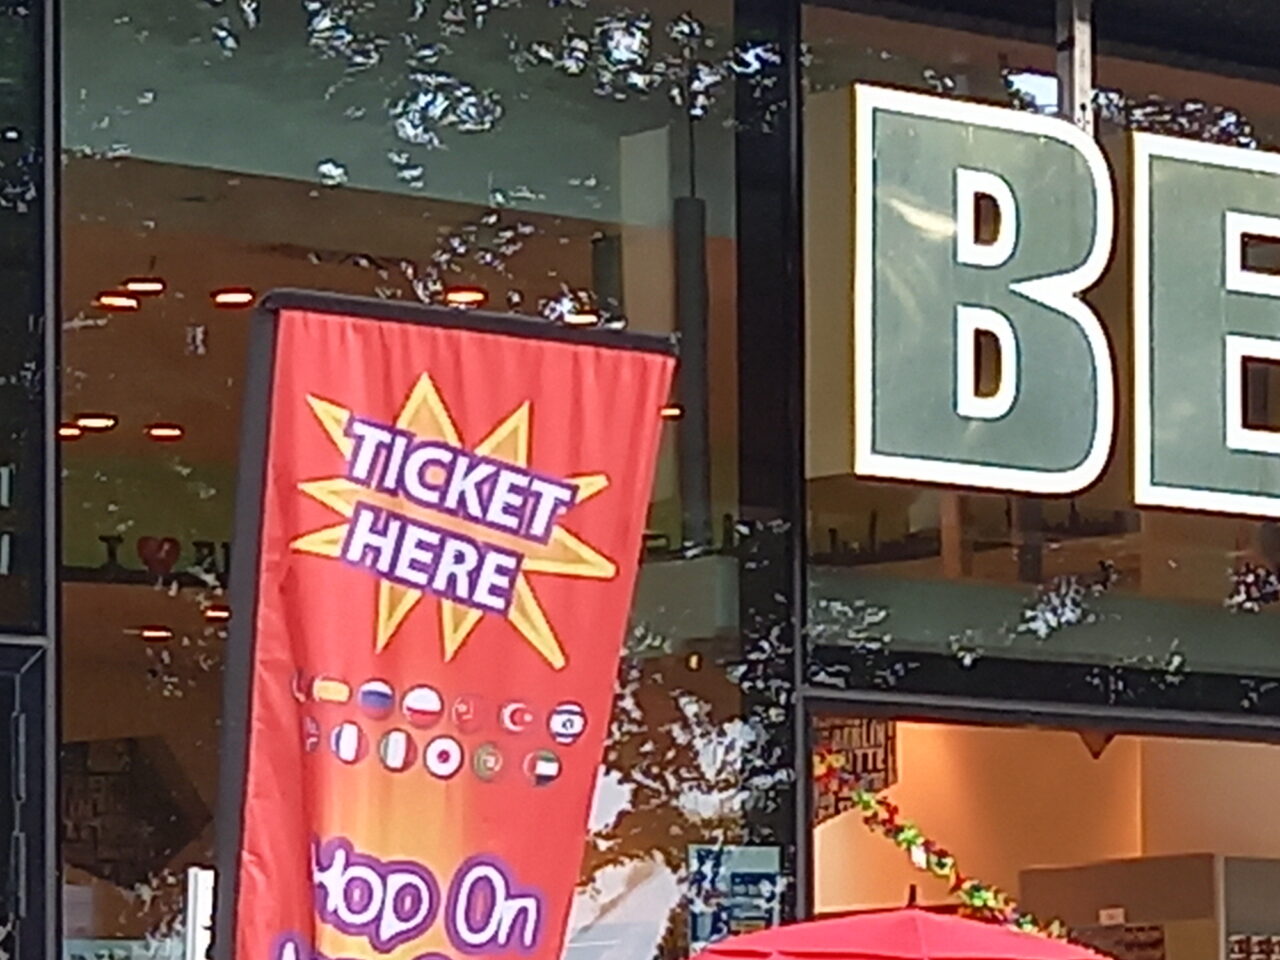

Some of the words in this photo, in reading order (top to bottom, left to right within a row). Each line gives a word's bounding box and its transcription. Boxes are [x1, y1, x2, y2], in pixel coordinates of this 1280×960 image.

[350, 420, 572, 538] TICKET
[345, 508, 517, 610] HERE
[454, 864, 538, 948] On
